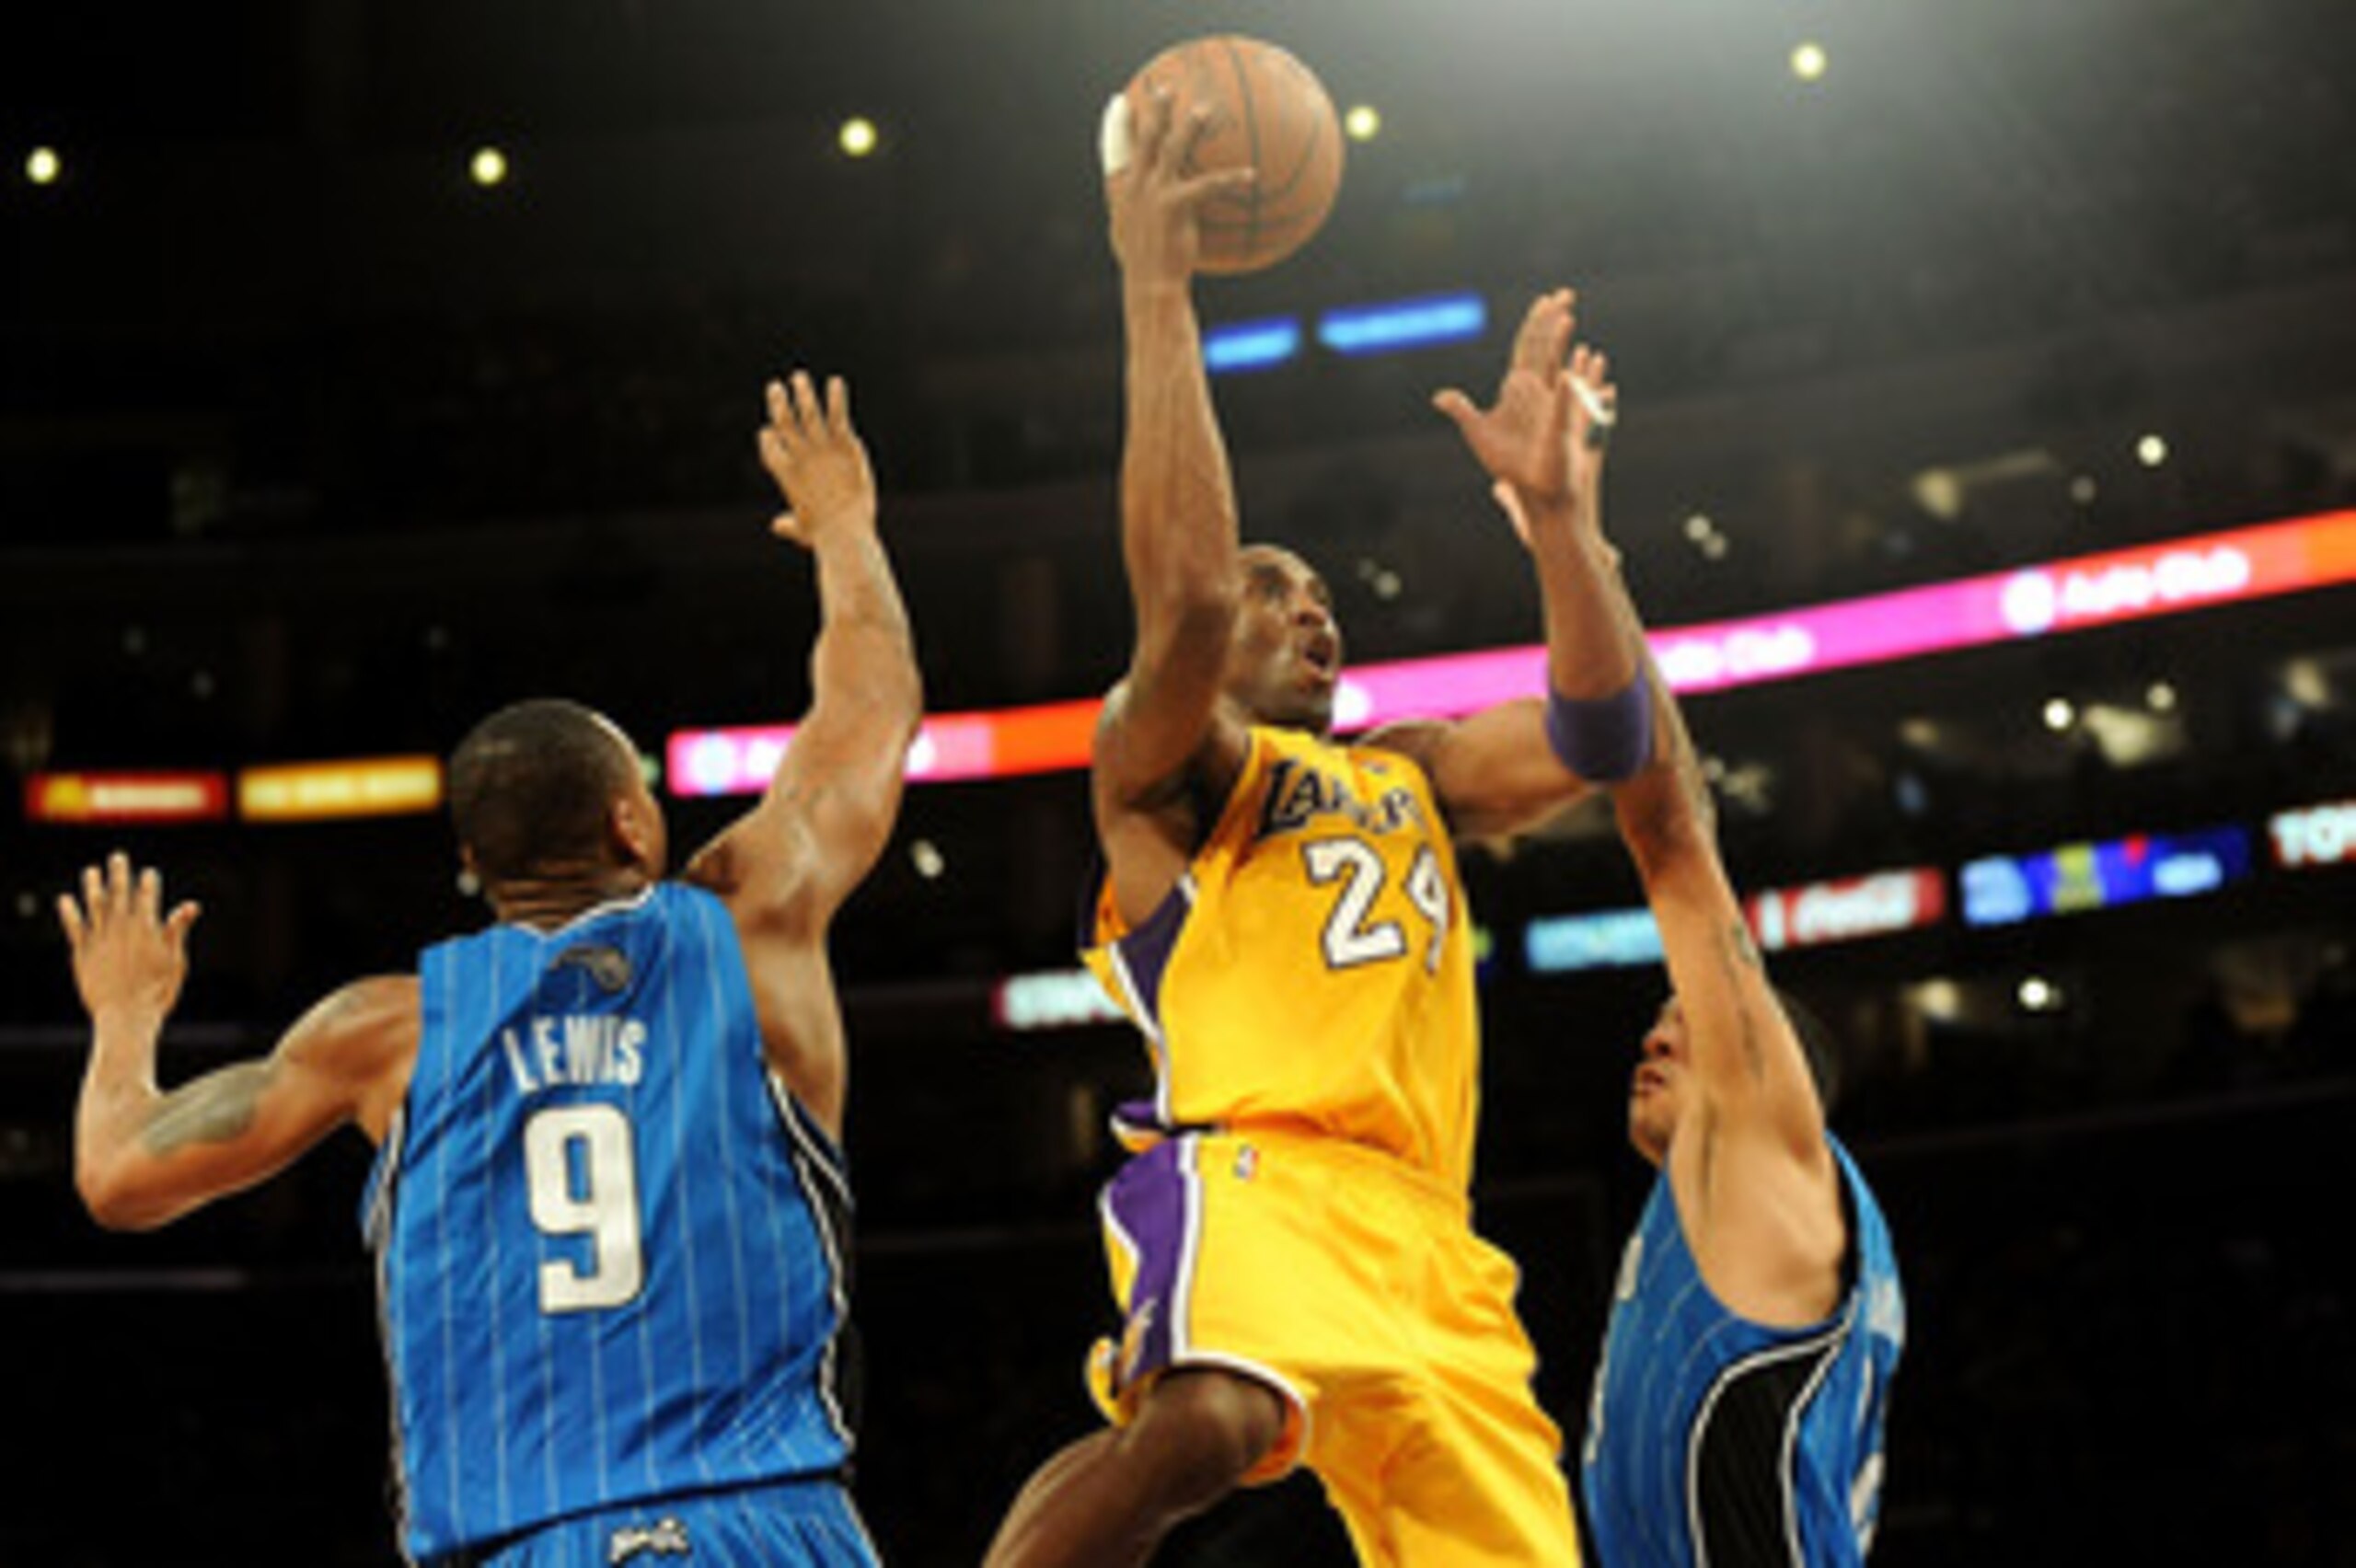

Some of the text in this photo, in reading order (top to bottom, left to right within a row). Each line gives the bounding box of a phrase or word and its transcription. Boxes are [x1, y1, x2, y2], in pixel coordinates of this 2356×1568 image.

[1299, 835, 1451, 977] 24
[502, 1013, 647, 1094] LEWIS
[524, 1102, 645, 1315] 9
